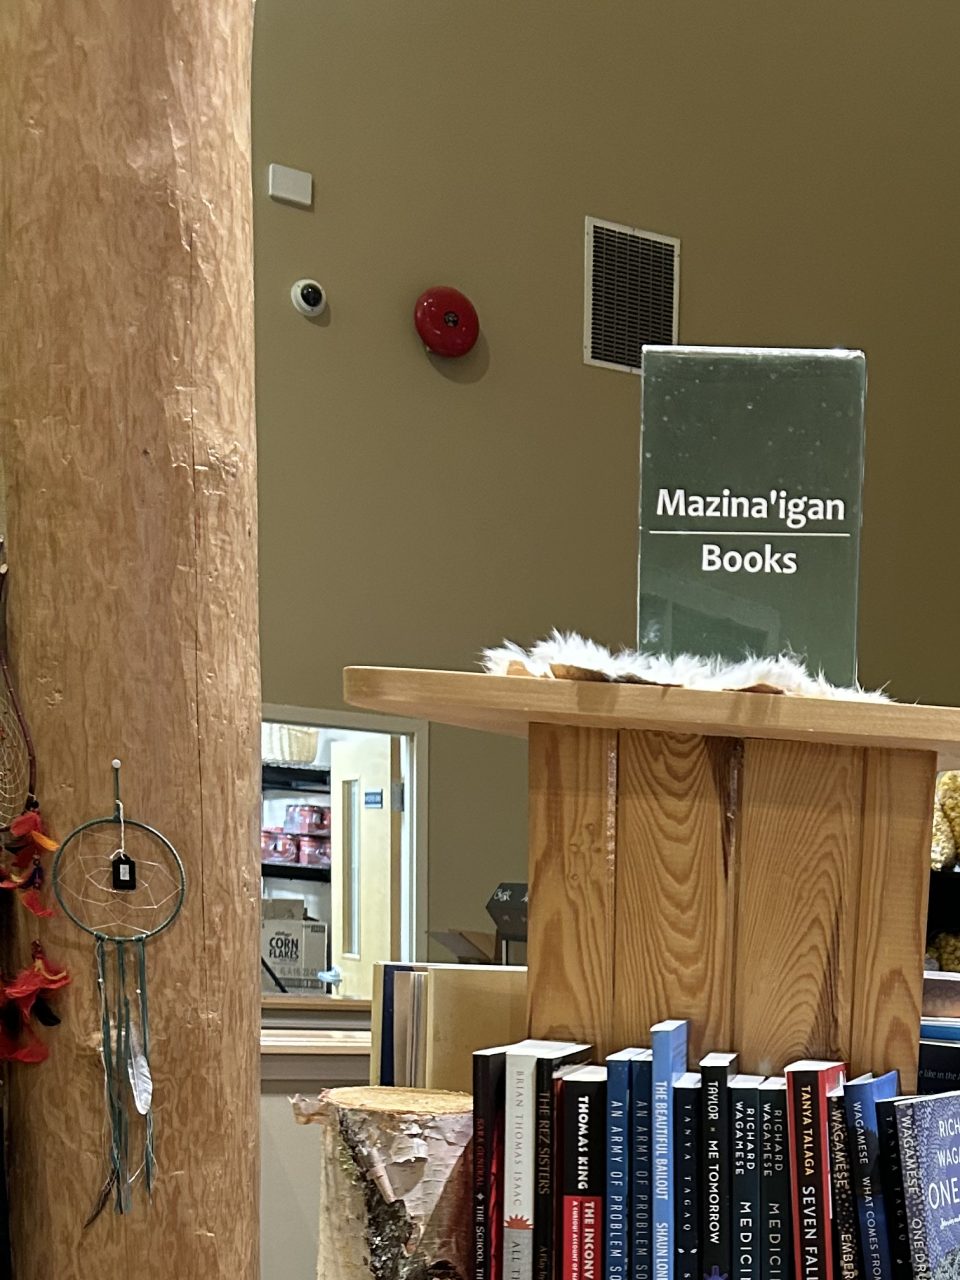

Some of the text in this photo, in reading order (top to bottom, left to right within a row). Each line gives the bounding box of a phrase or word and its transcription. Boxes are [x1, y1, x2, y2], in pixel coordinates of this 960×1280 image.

[656, 488, 846, 529] Mazina'igan
[701, 544, 798, 574] Books
[269, 937, 299, 949] CORN
[269, 949, 299, 959] FLAKES
[610, 1101, 623, 1117] AN
[636, 1101, 648, 1117] AN
[707, 1081, 719, 1120] TAYLOR
[513, 1070, 524, 1207] BRIAN THOMAS ISAAC
[539, 1092, 550, 1195] THE REZ SISTERS
[578, 1096, 589, 1190] THOMAS KING
[610, 1126, 623, 1163] ARMY
[635, 1126, 648, 1162] ARMY
[655, 1081, 668, 1200] THE BEAUTIFUL BAILOUT
[735, 1101, 744, 1175] WAGAMESE
[746, 1108, 755, 1170] RICHARD
[763, 1103, 772, 1177] WAGAMESE
[774, 1109, 783, 1171] RICHARD
[801, 1085, 815, 1176] TANYA TALAGA
[831, 1110, 848, 1188] WAGAMESE
[853, 1101, 869, 1164] WAGAMESE
[886, 1116, 899, 1171] TANYA
[683, 1104, 691, 1231] TANYA TAGAQ
[901, 1116, 919, 1194] WAGAMESE
[610, 1171, 623, 1187] OF
[635, 1170, 648, 1186] OF
[708, 1140, 720, 1244] ME TOMORROW
[862, 1176, 873, 1208] WHAT
[928, 1177, 960, 1209] ONE
[475, 1204, 485, 1223] THE
[583, 1201, 594, 1224] THE
[609, 1196, 623, 1257] PROBLEM
[635, 1195, 648, 1256] PROBLEM
[802, 1186, 817, 1239] SEVEN
[866, 1210, 878, 1249] COMES
[475, 1225, 485, 1264] SCHOOL
[511, 1241, 520, 1262] ALL
[655, 1222, 668, 1257] SHAUN
[912, 1218, 925, 1249] ONE
